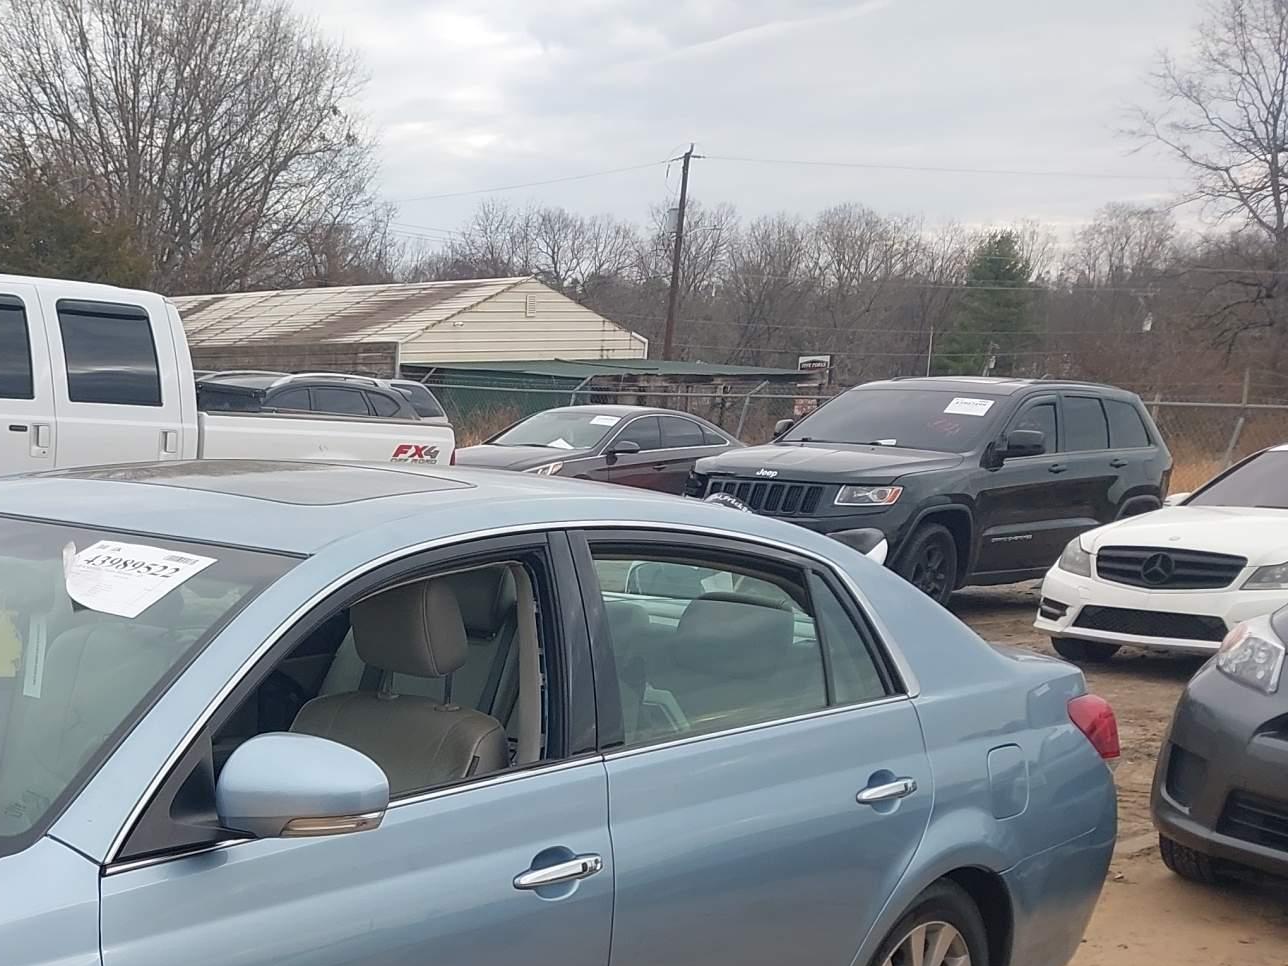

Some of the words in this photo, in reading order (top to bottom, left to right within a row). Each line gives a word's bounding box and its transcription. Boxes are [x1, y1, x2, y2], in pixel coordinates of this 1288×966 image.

[392, 444, 440, 459] FX4
[756, 468, 778, 478] Jeep
[83, 553, 181, 579] 43989522
